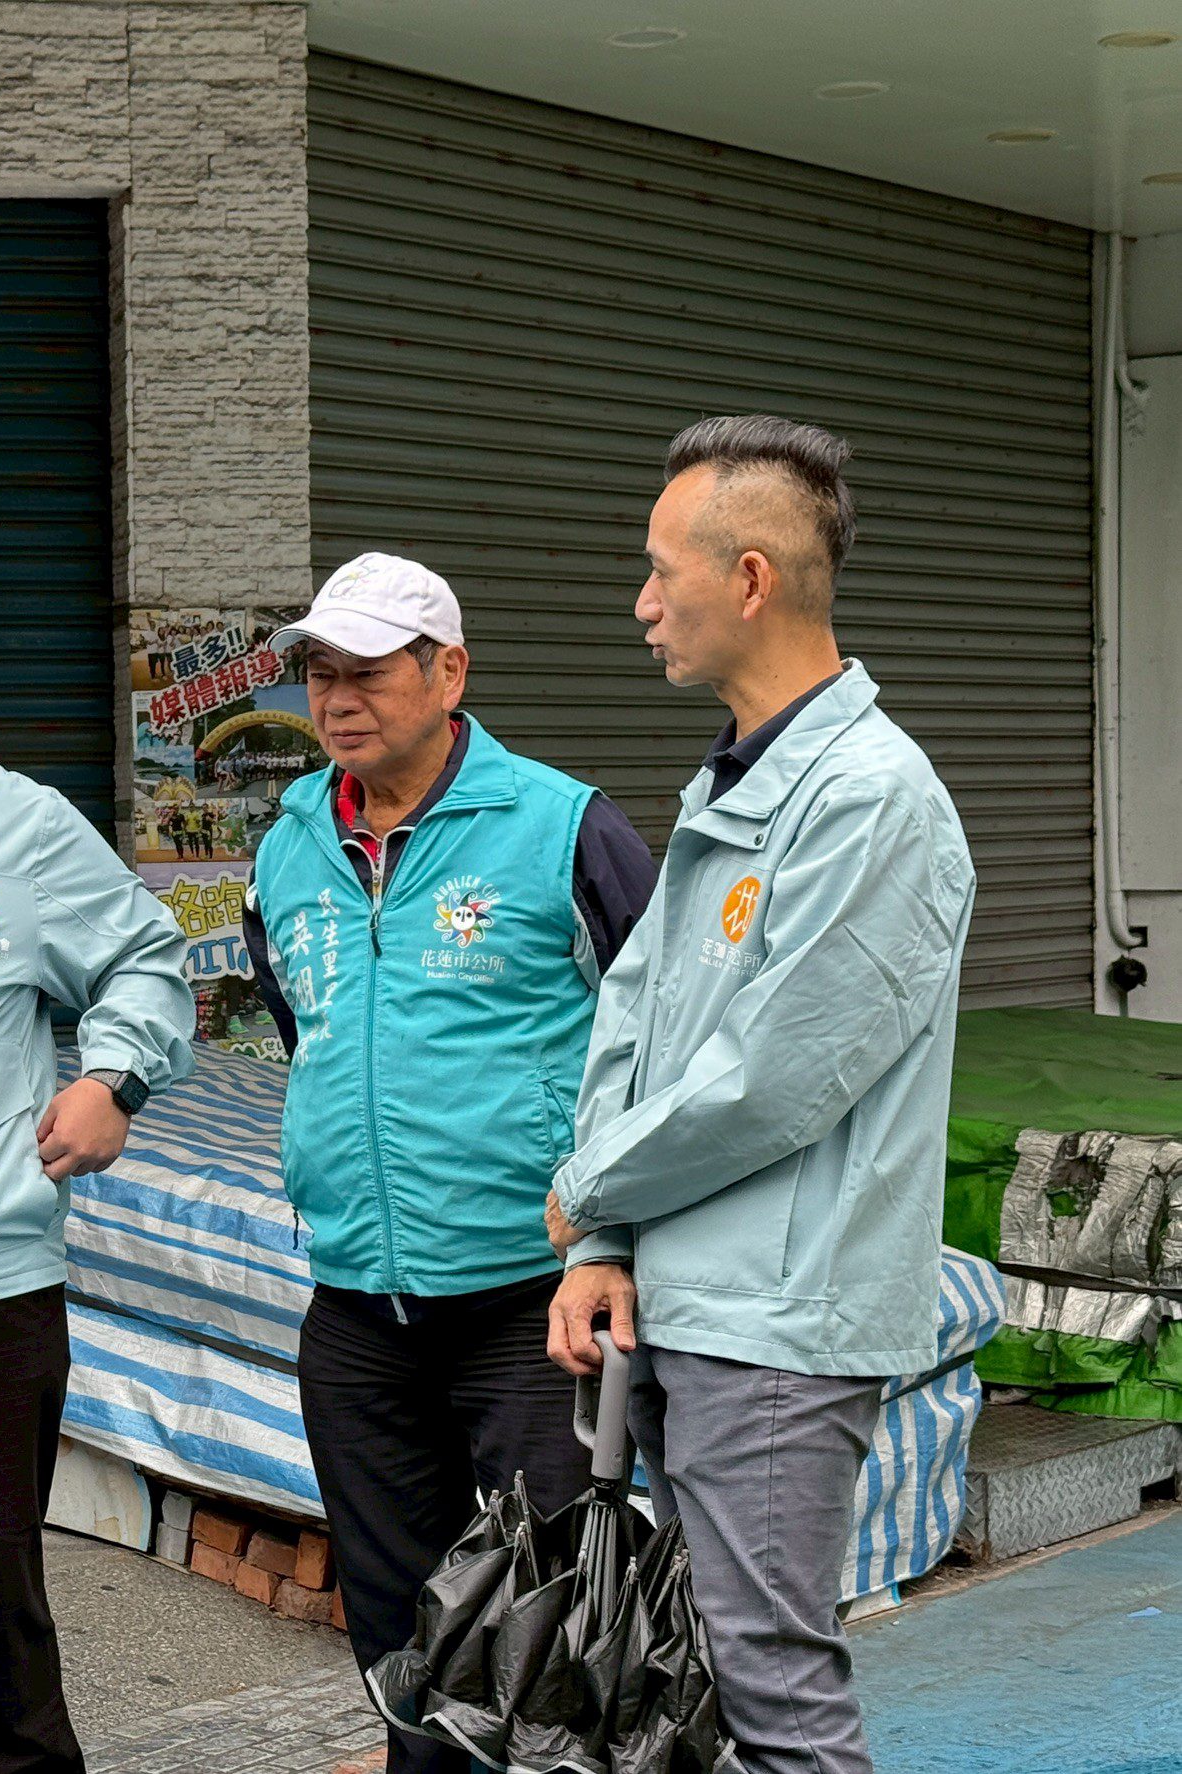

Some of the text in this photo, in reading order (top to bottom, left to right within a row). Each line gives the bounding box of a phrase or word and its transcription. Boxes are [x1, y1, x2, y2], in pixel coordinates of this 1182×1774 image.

[150, 650, 282, 727] 媒體報導
[421, 949, 506, 973] 花蓮市公所
